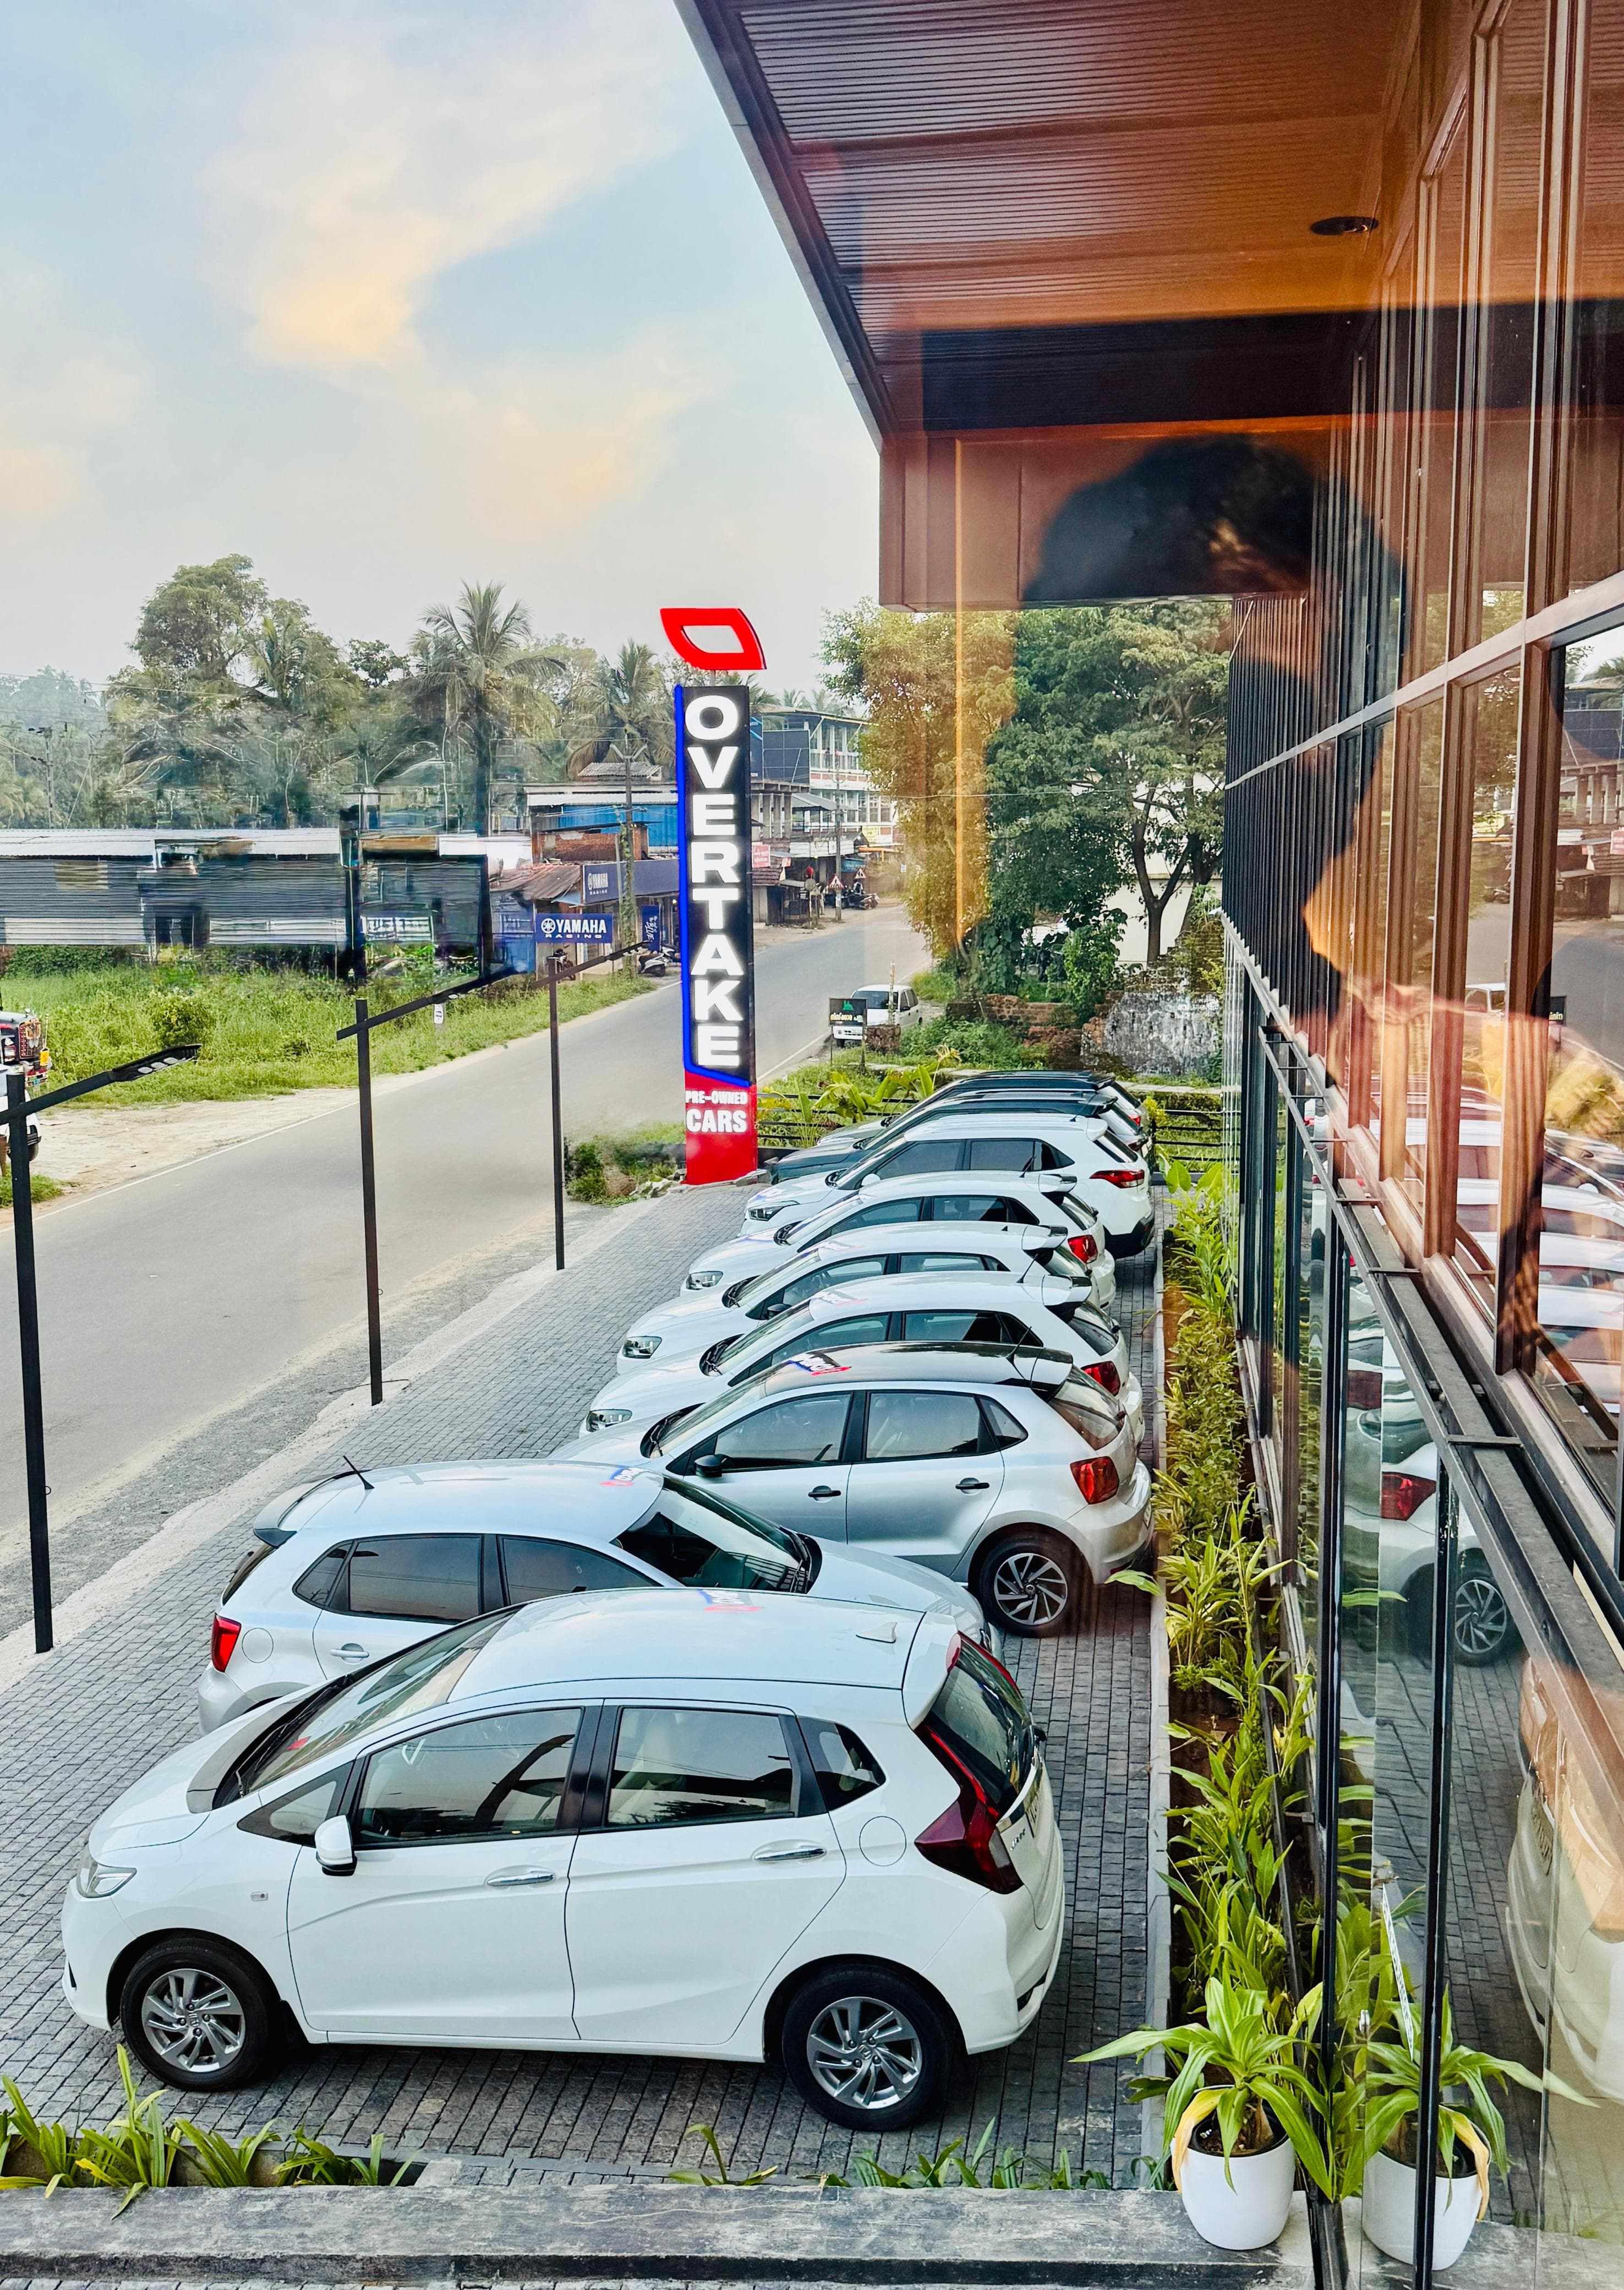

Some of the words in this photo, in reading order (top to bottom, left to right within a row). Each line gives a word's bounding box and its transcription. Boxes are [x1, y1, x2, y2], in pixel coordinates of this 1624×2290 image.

[592, 873, 609, 889] YAMAHA
[685, 695, 743, 1066] OVERTAKE
[556, 919, 607, 933] YAMAHA
[685, 1091, 748, 1105] PRE-OWNED
[686, 1108, 747, 1133] CARS
